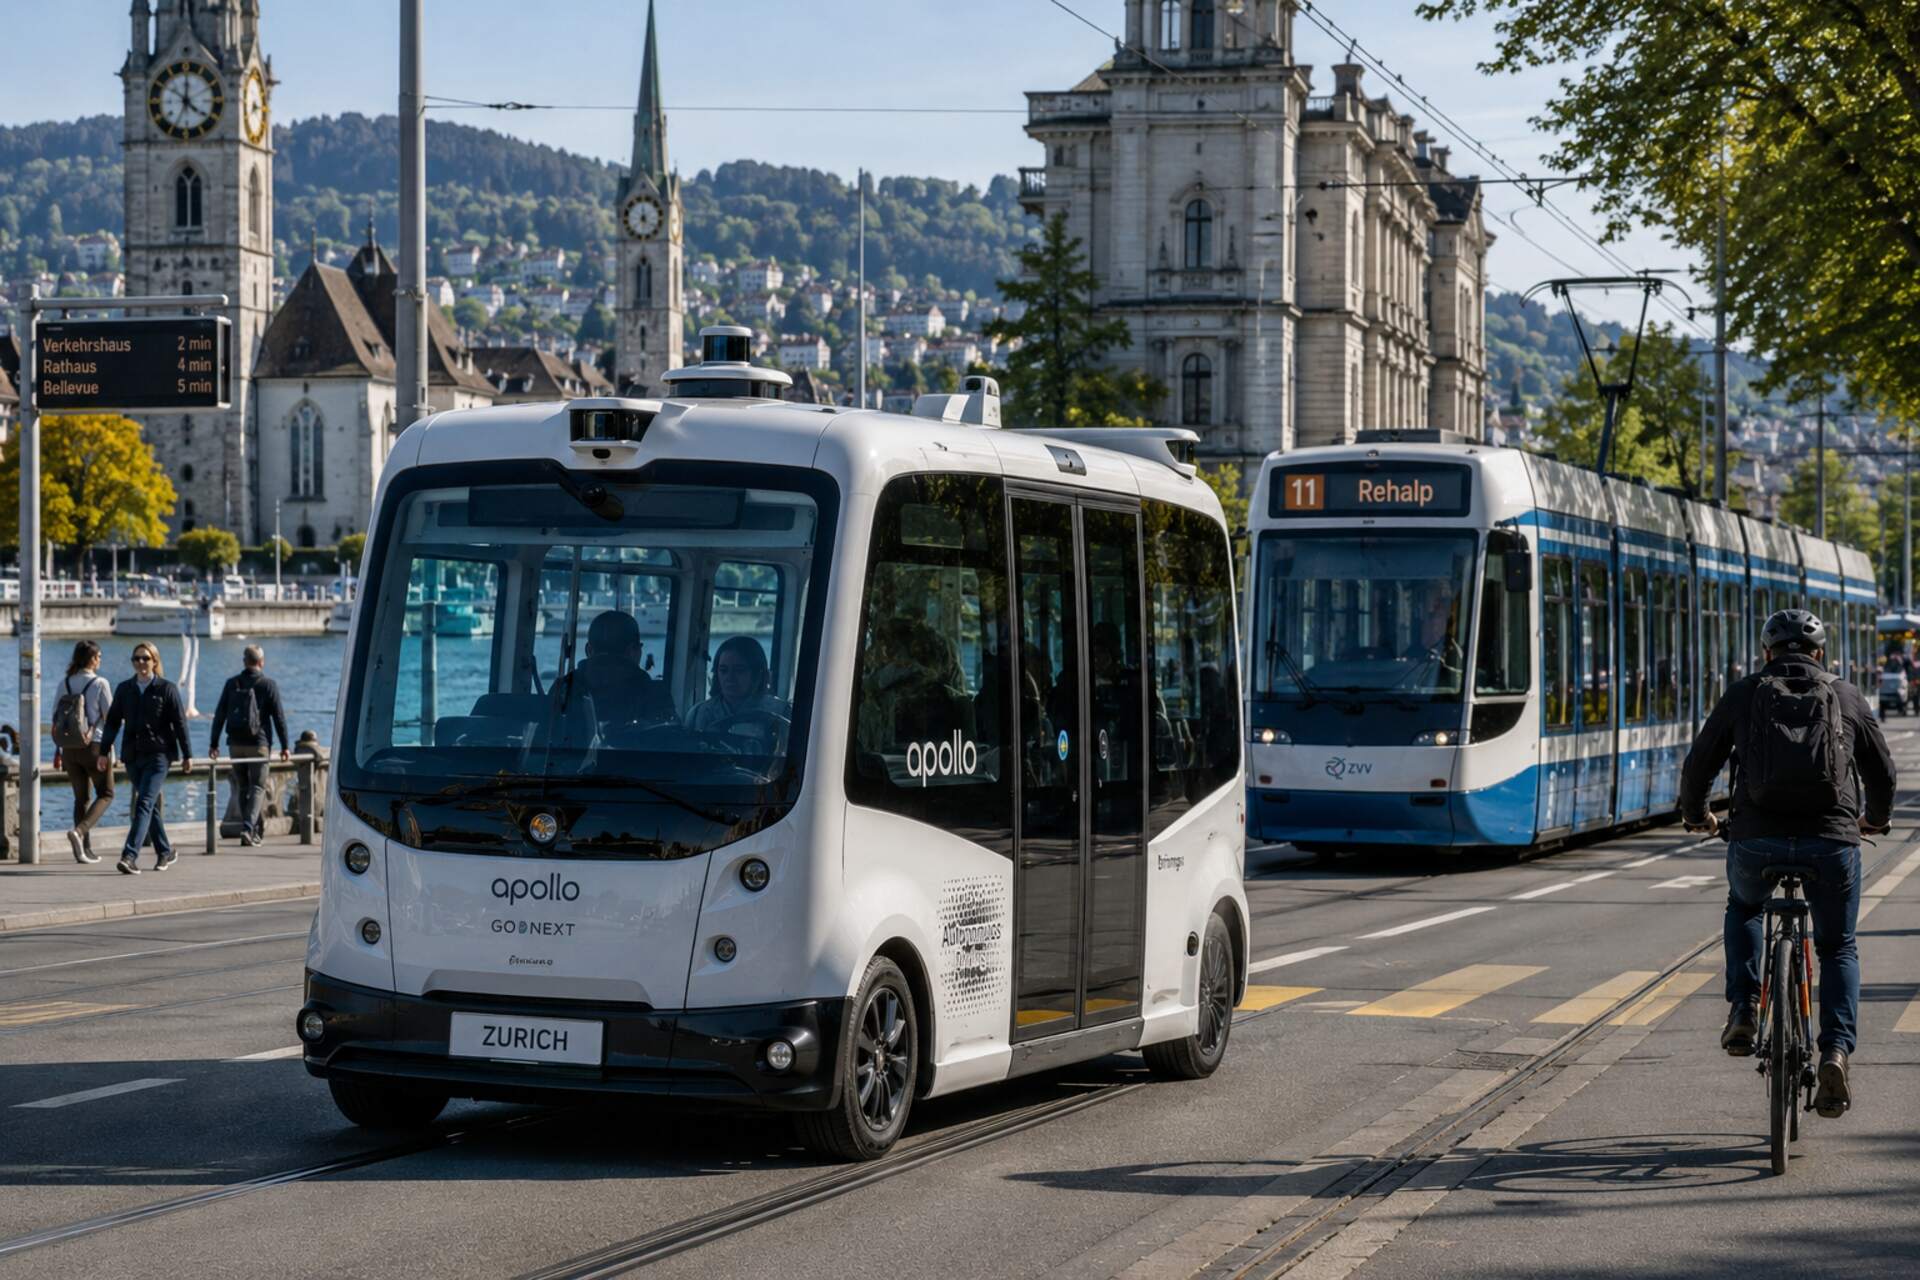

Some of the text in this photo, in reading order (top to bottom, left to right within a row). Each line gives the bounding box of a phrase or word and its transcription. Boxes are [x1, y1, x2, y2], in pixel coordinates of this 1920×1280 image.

[43, 336, 211, 352] Verkehrshaus 2 min
[43, 357, 211, 373] Rathaus 4 min
[43, 379, 212, 394] Bellevue 5 min
[1292, 478, 1433, 507] 11 Rehalp
[907, 729, 977, 787] apollo
[1348, 763, 1372, 774] ZVV
[491, 873, 580, 905] apollo
[482, 1025, 568, 1051] ZURICH
